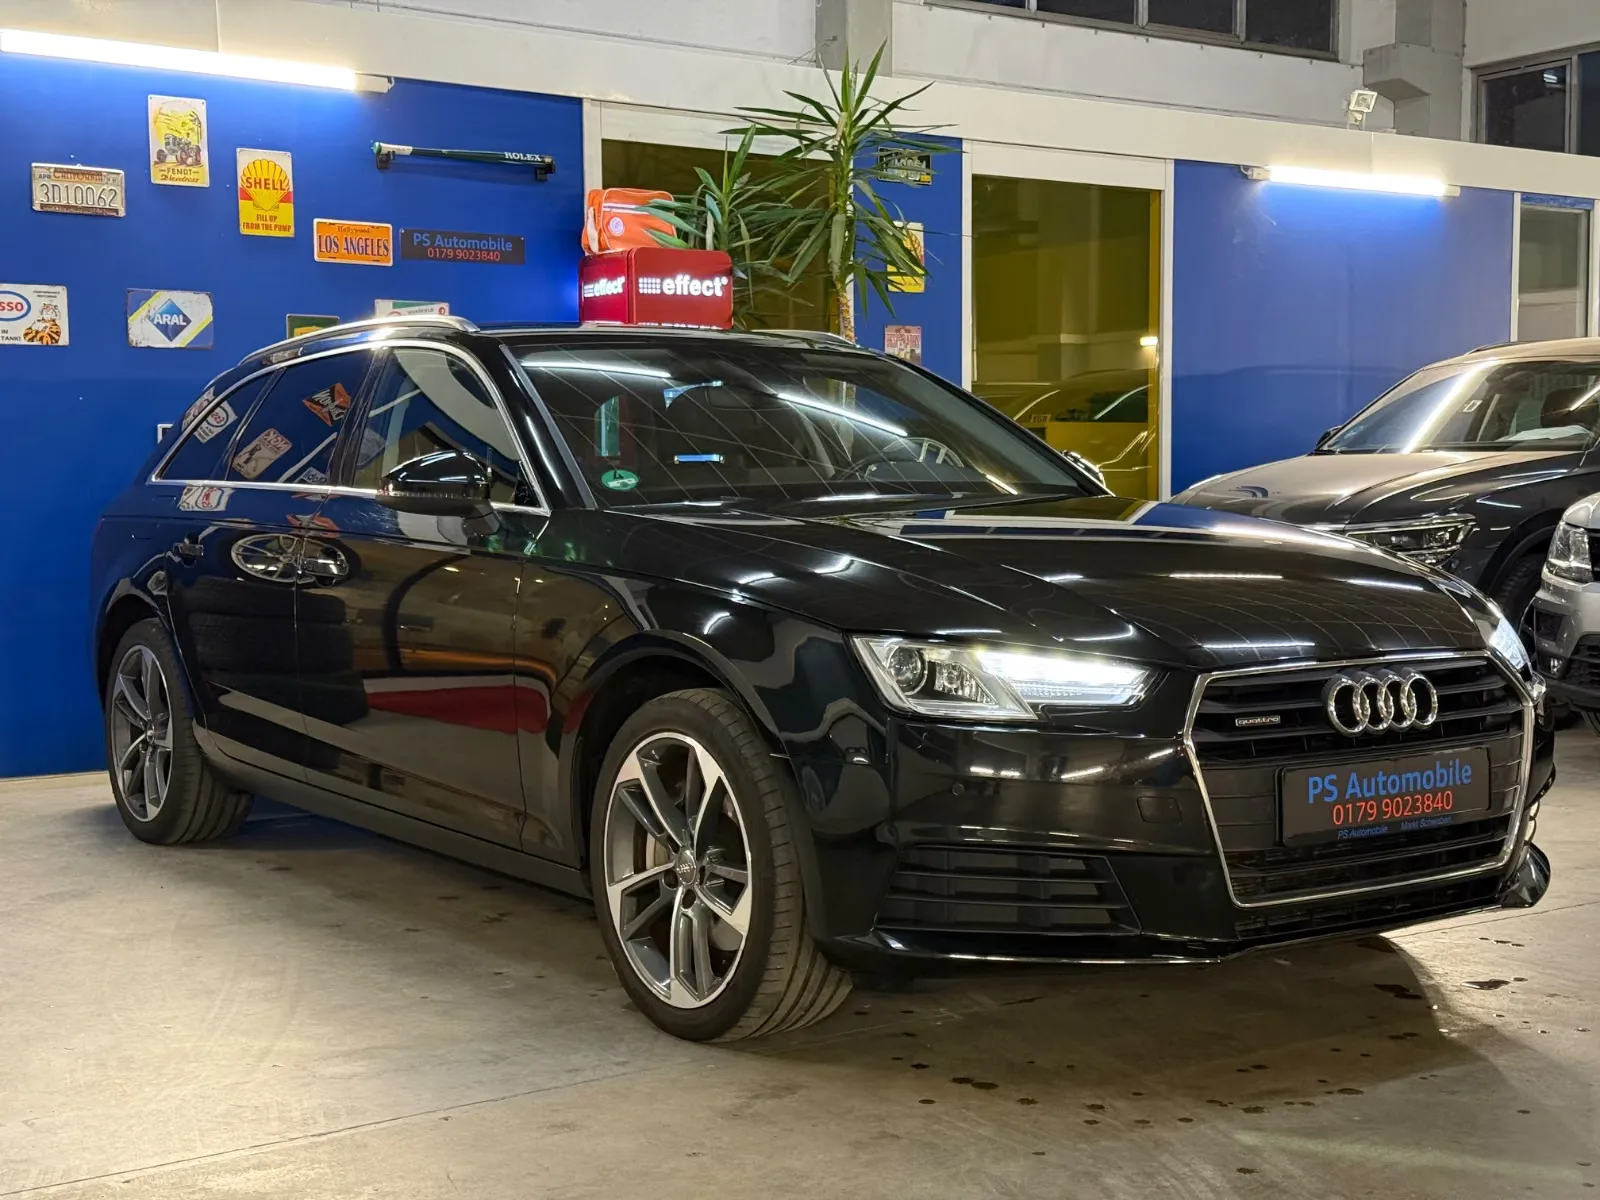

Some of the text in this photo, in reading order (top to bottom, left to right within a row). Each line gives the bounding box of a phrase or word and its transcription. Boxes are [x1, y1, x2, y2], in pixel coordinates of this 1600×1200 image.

[503, 151, 542, 163] ROLEX
[166, 167, 193, 176] FENDT
[245, 176, 287, 192] SHELL
[39, 182, 119, 208] 3D10062
[256, 213, 269, 222] FILL
[242, 221, 292, 233] FROM THE PUMP
[318, 234, 390, 257] LOS ANGELES
[412, 232, 513, 252] PS Automobile
[426, 247, 501, 262] 0179 9023840
[662, 273, 724, 297] effect
[153, 313, 187, 326] ARAL
[1237, 717, 1280, 726] quattro
[1307, 758, 1473, 804] PS Automobile
[1332, 790, 1454, 826] 0179 9023840
[1337, 829, 1349, 840] PS
[1349, 825, 1389, 839] Automobile
